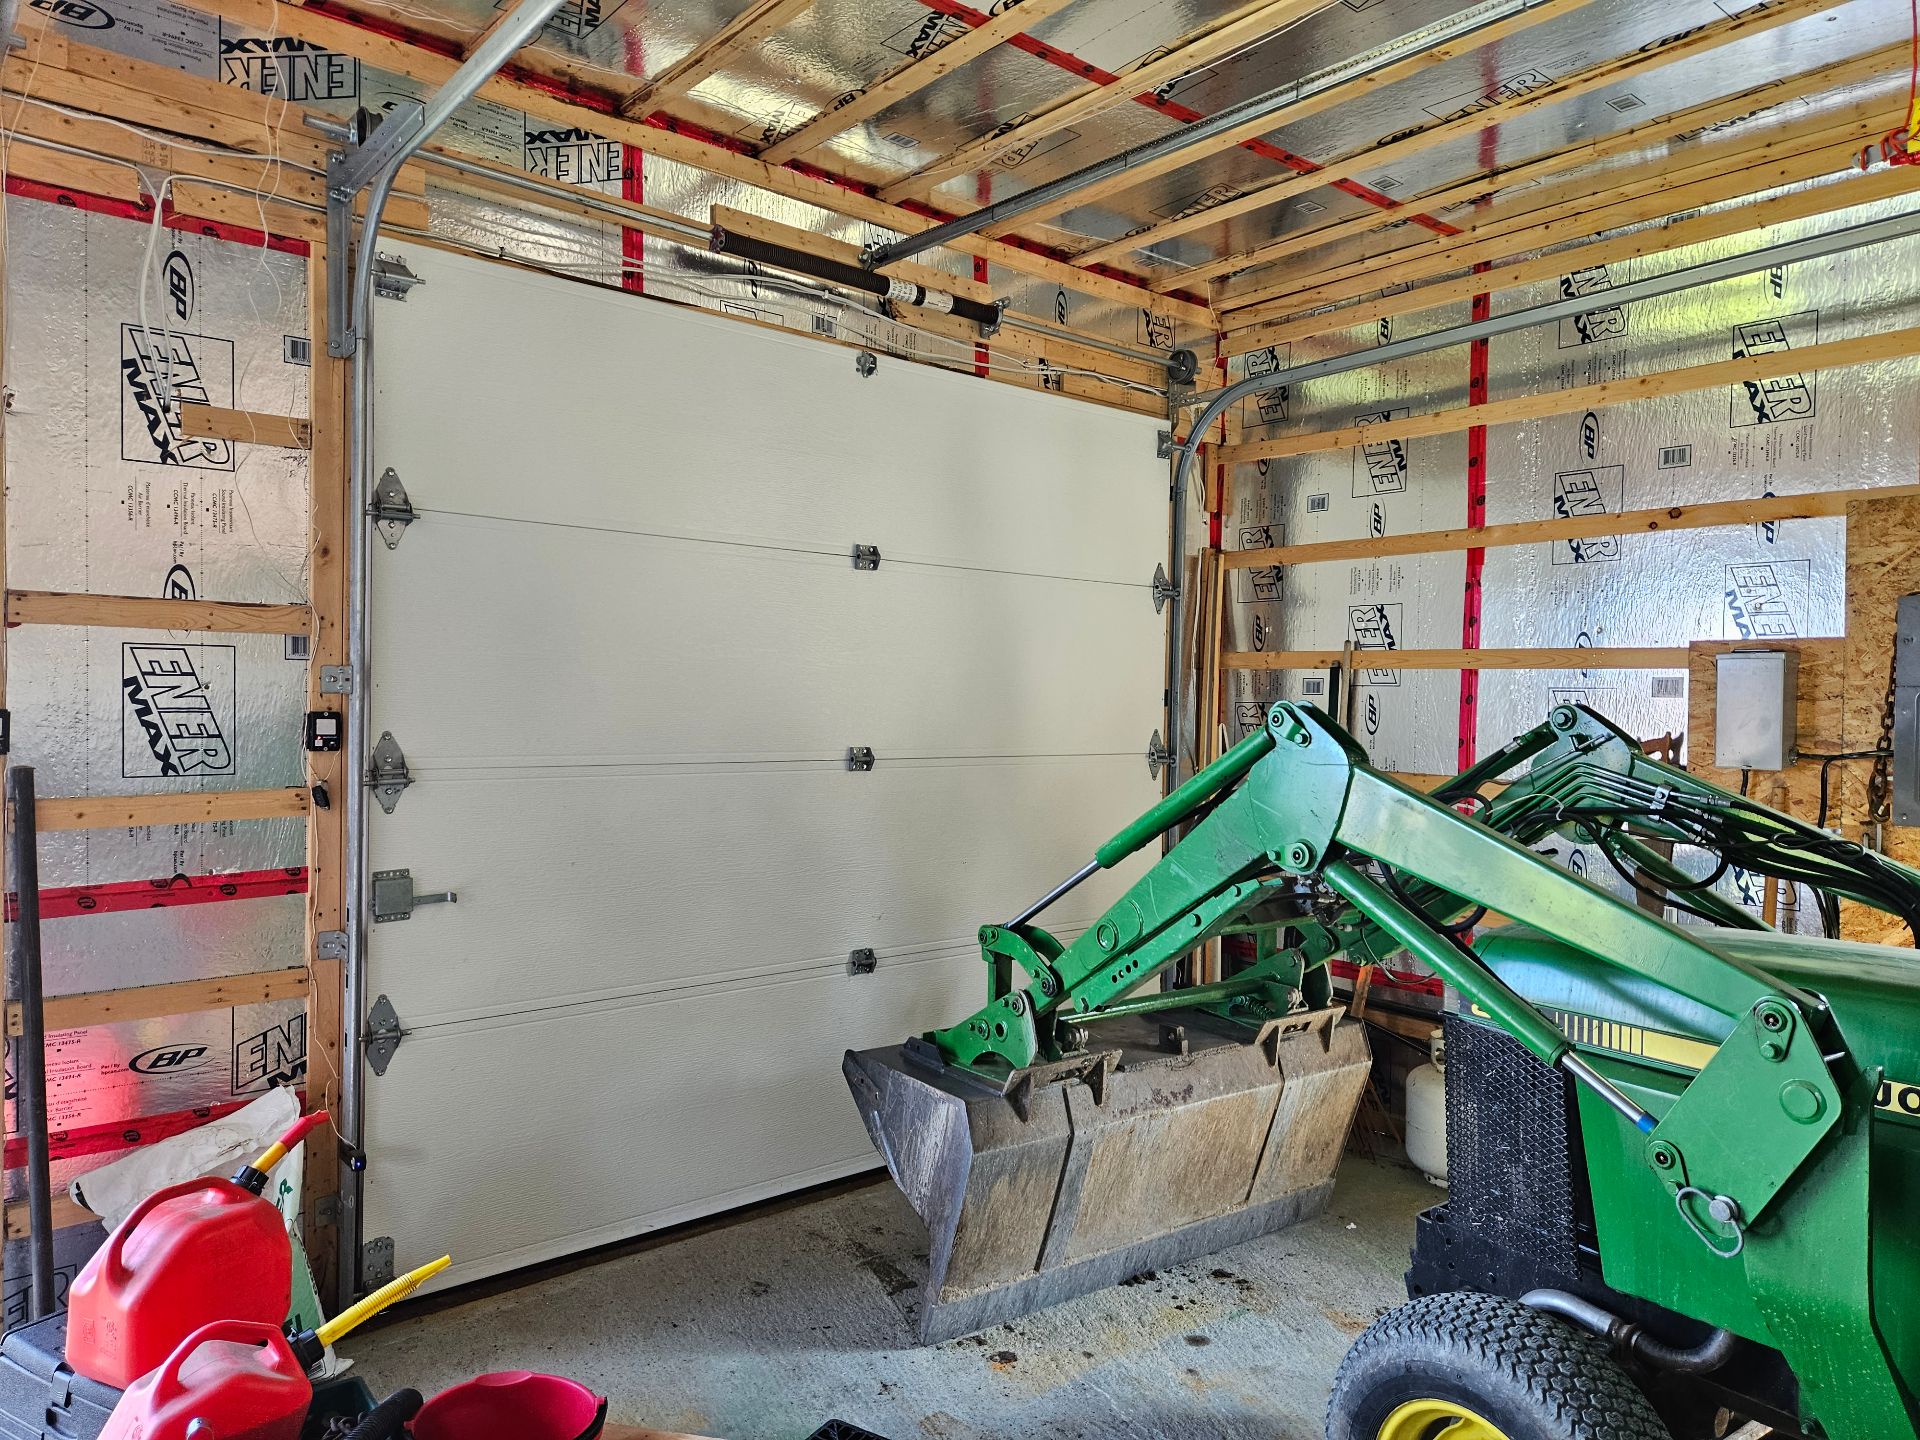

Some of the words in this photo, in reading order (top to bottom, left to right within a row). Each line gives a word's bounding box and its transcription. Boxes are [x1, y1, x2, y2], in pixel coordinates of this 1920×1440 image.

[29, 0, 97, 21] BP
[170, 264, 187, 321] BP
[1247, 348, 1286, 422] ENR
[1739, 320, 1812, 419] EER
[122, 358, 179, 465] MAX
[1584, 424, 1594, 459] BP
[1373, 502, 1384, 535] BP
[1559, 471, 1618, 559] ENR
[1241, 530, 1281, 600] ENR
[1255, 615, 1266, 645] BP
[1725, 589, 1751, 640] MA
[1730, 565, 1798, 638] ENE
[1351, 608, 1397, 685] EER
[123, 675, 181, 776] MAX
[130, 646, 232, 773] ENER
[1367, 694, 1376, 725] BP
[150, 1046, 207, 1068] BP
[236, 1012, 307, 1090] EN
